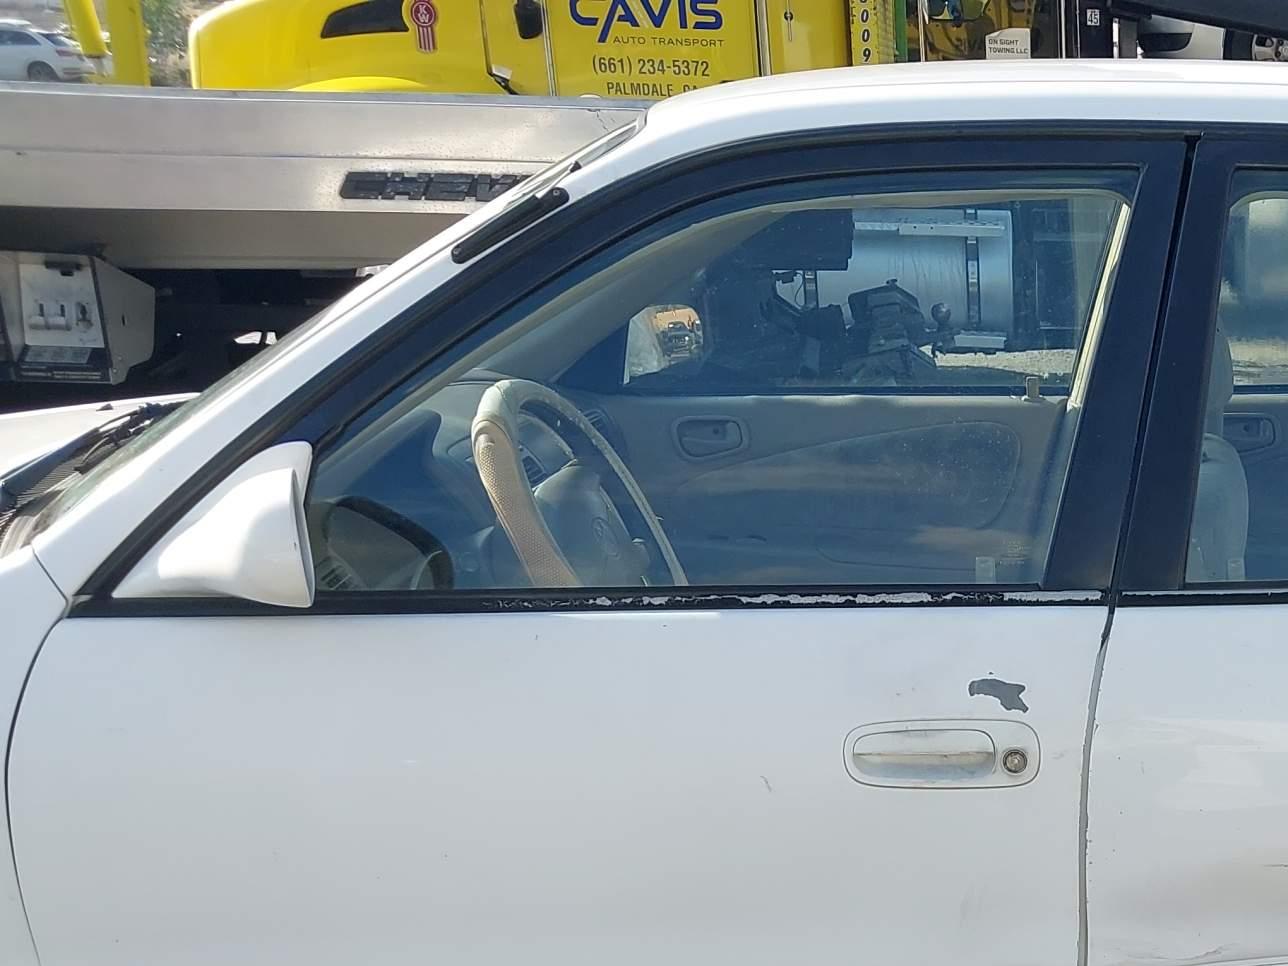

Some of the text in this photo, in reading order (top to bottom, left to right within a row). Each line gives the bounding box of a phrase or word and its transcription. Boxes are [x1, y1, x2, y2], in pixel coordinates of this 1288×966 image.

[569, 0, 723, 43] CAVIS
[1088, 11, 1099, 25] 45
[613, 36, 725, 47] AUTO TRANSPORT
[859, 0, 872, 62] 009
[592, 56, 710, 77] (661) 234-5372
[607, 82, 673, 97] PALMDALE
[340, 171, 536, 201] CHEV
